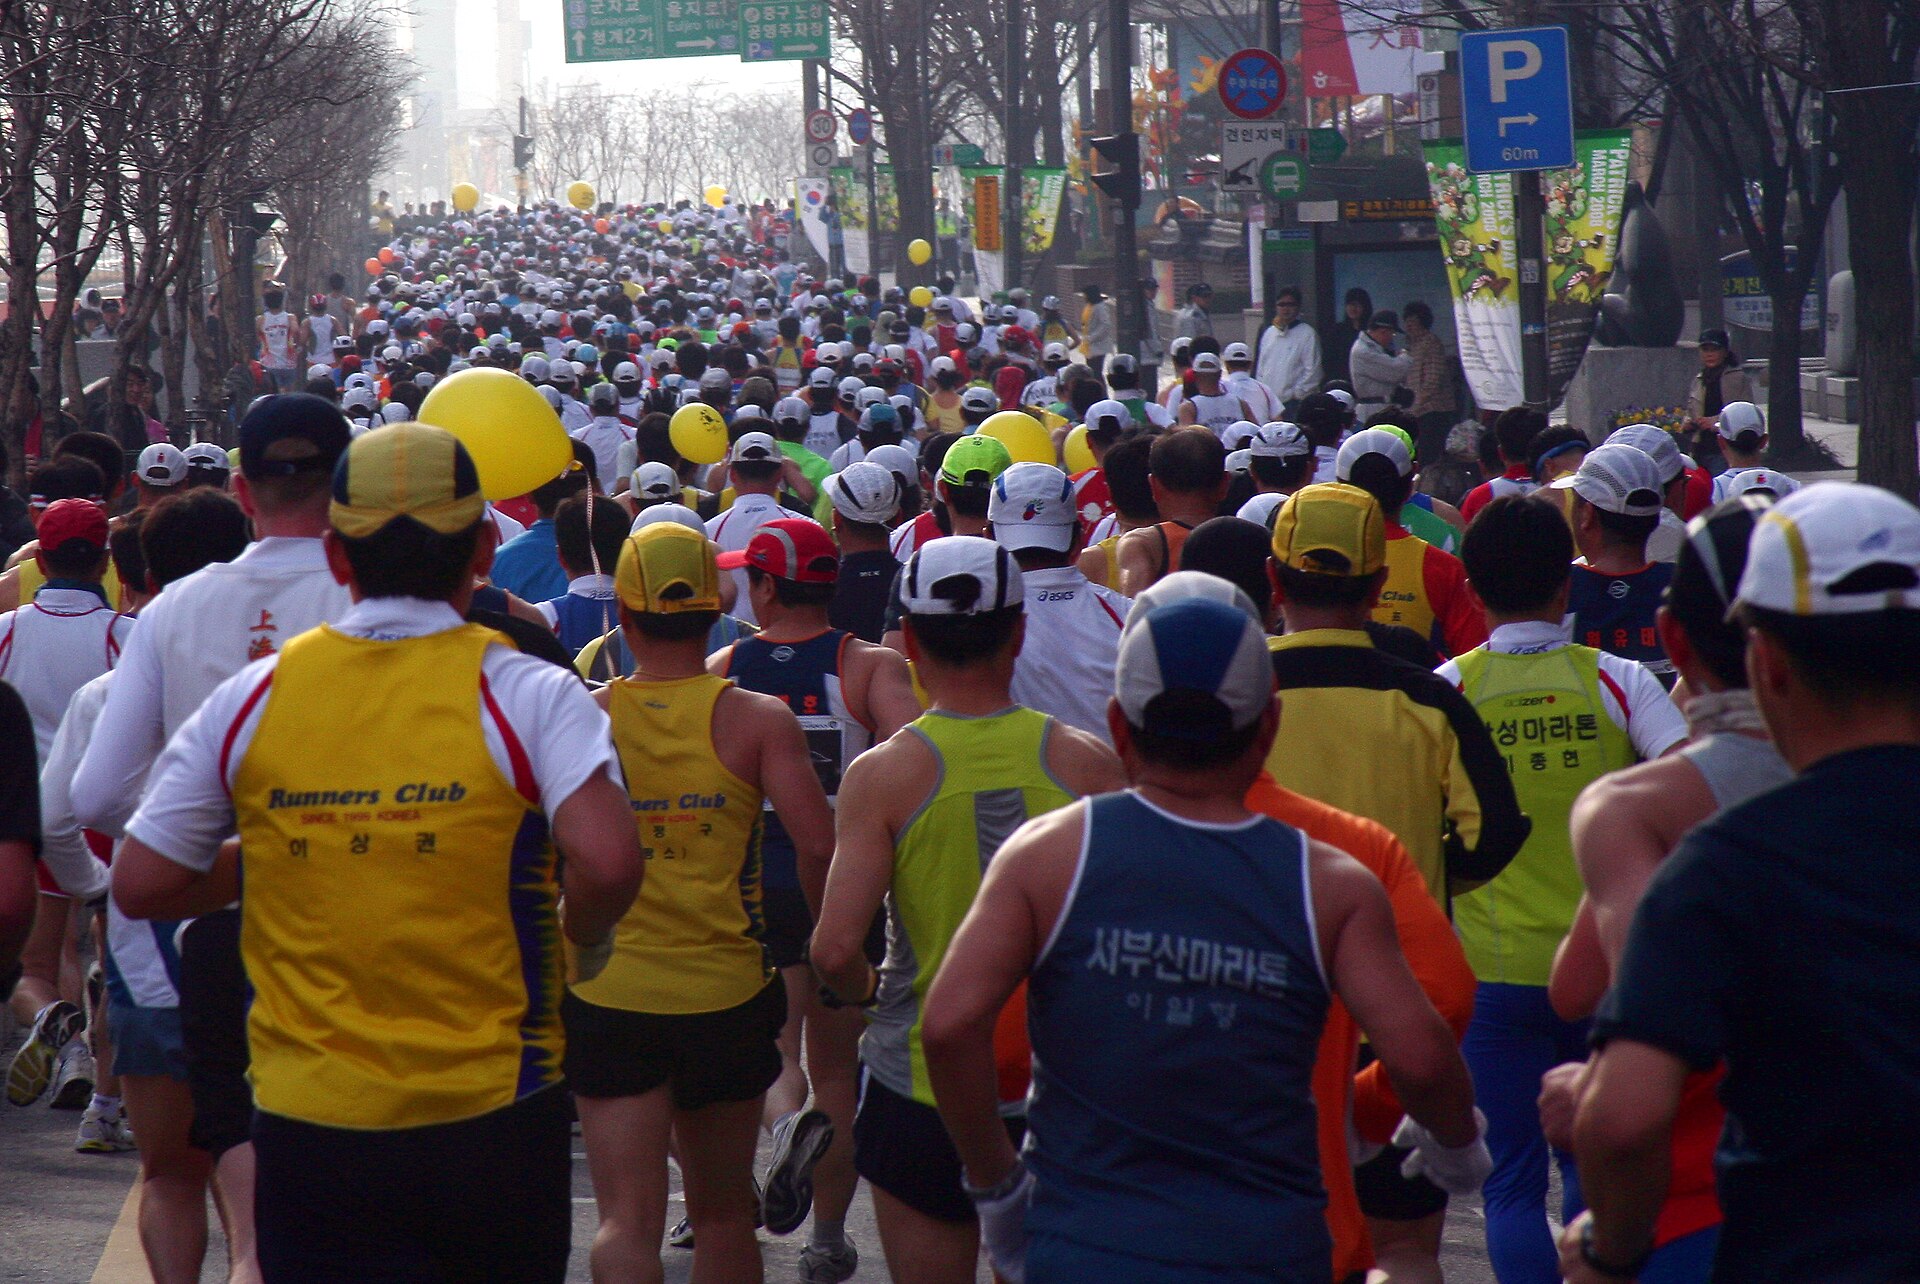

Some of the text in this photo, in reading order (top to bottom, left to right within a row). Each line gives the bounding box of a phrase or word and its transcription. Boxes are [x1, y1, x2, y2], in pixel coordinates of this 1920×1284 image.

[1488, 40, 1543, 103] P
[1226, 128, 1284, 143] 견인지역
[1502, 146, 1540, 161] 60m
[269, 782, 466, 809] Runners Club
[679, 793, 726, 809] Club
[1086, 926, 1289, 999] 서부산마라톤
